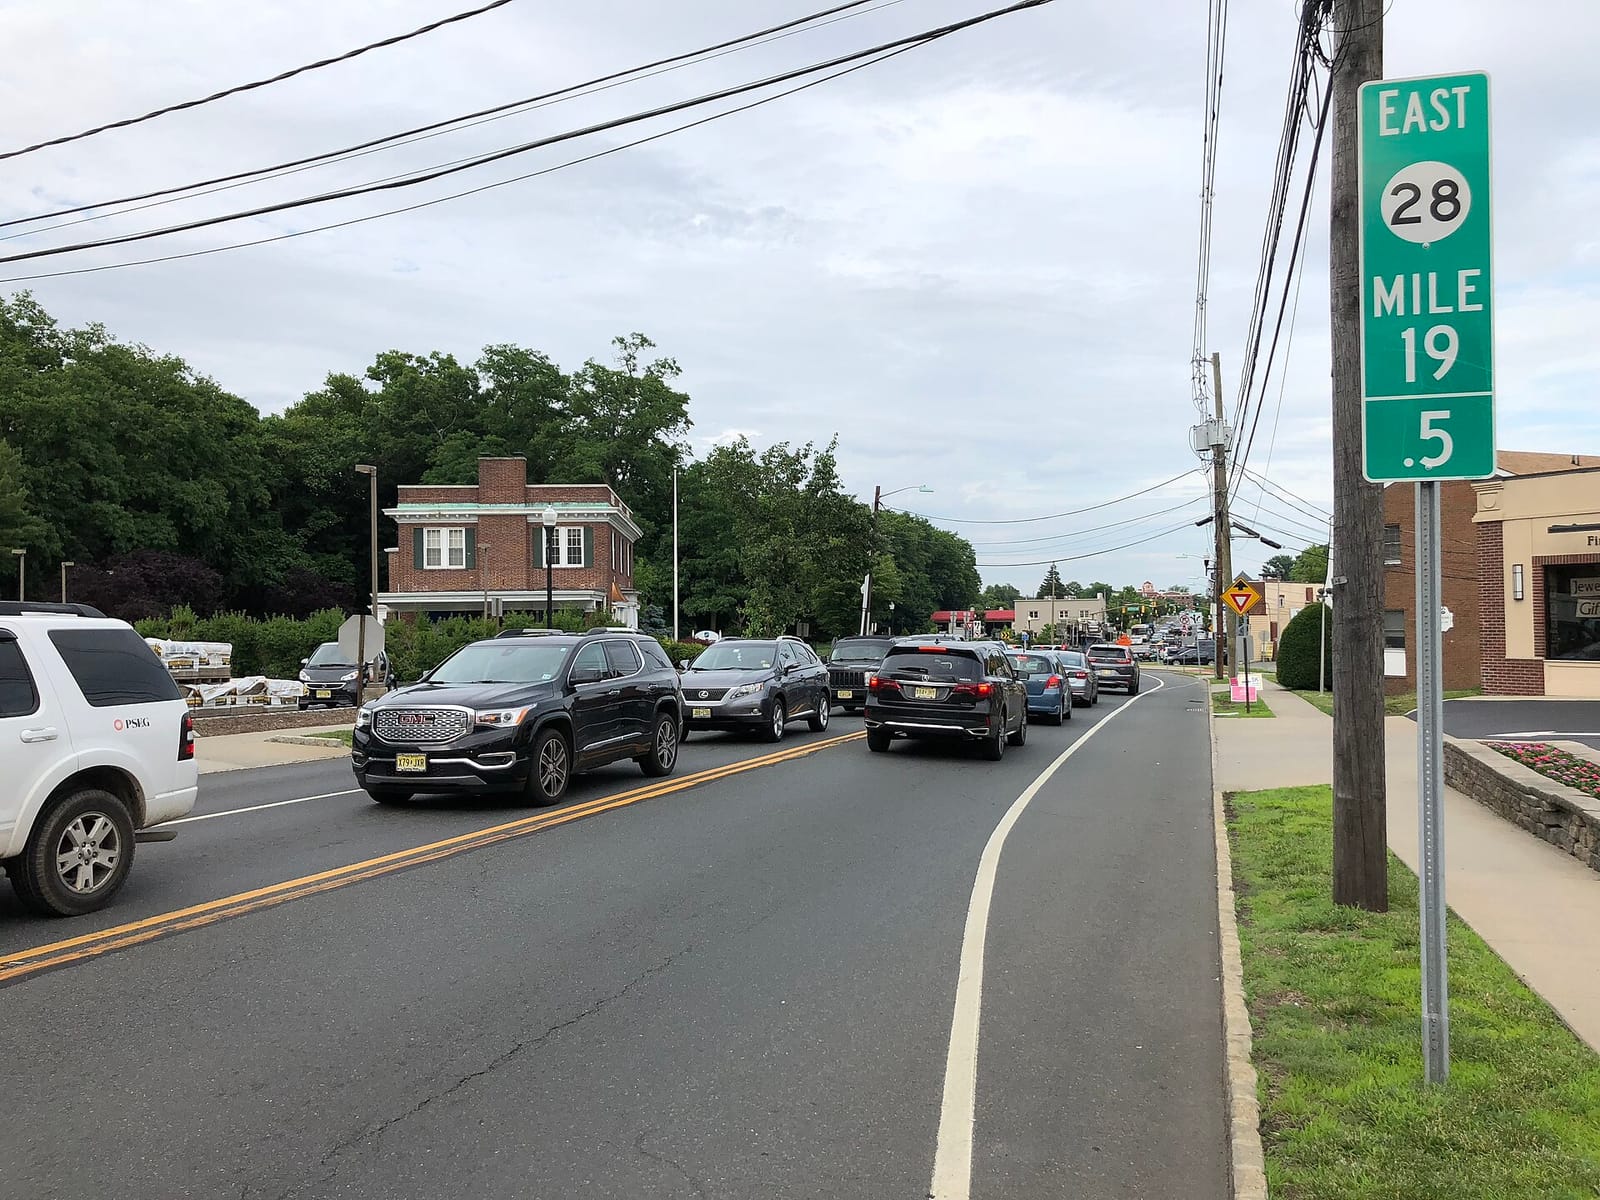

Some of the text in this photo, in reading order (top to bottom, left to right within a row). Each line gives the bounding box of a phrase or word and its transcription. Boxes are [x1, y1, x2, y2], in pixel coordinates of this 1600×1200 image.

[1379, 86, 1471, 136] EAST
[1390, 179, 1461, 226] 28
[1373, 268, 1483, 318] MILE
[1401, 324, 1459, 383] 19
[1403, 410, 1454, 467] .5
[125, 717, 150, 729] PSEG
[400, 714, 434, 724] GMC
